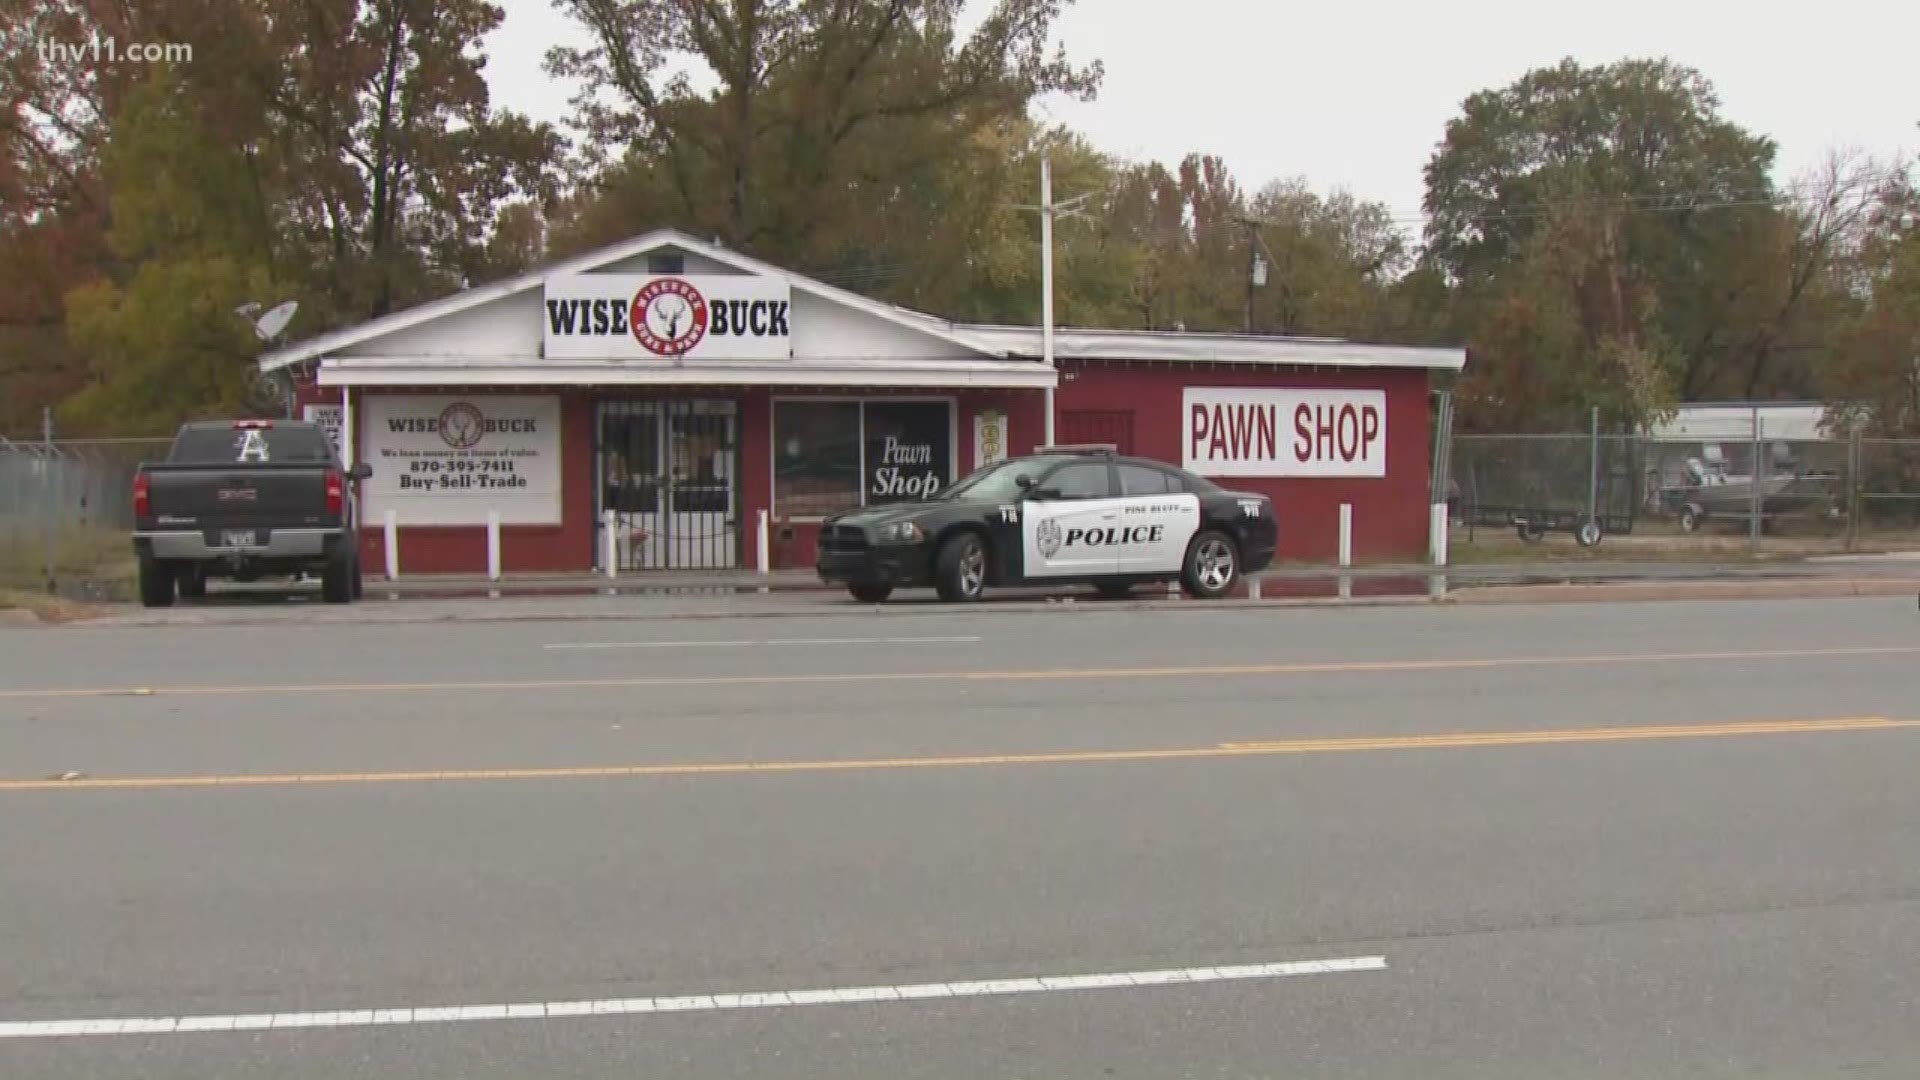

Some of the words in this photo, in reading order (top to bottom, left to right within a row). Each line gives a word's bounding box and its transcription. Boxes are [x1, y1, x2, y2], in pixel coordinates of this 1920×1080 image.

[547, 299, 628, 336] WISE
[709, 299, 789, 337] BUCK
[388, 418, 437, 433] WISE
[485, 418, 536, 433] BUCK
[1191, 403, 1276, 461] PAWN
[1294, 402, 1379, 462] SHOP
[423, 450, 454, 458] money
[882, 436, 931, 465] Pawn
[873, 467, 940, 500] Shop
[1125, 506, 1146, 514] PINE
[1151, 504, 1180, 513] BLUFF
[1065, 524, 1164, 547] POLICE
